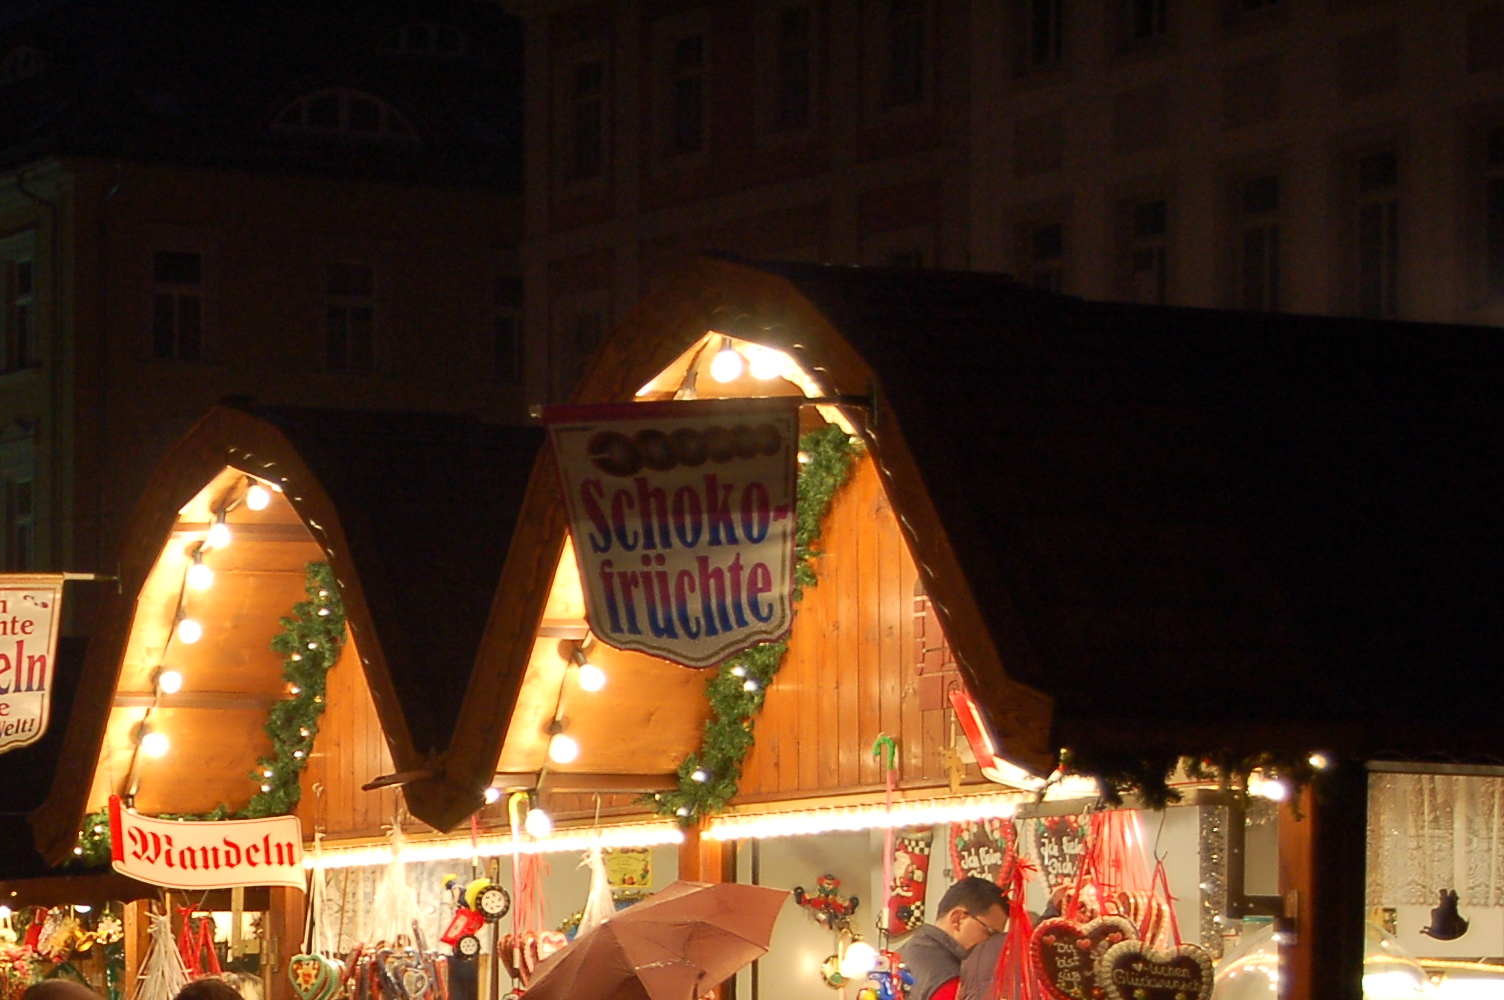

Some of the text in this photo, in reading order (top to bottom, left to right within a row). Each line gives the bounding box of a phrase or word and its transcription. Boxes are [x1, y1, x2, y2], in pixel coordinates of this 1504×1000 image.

[580, 474, 789, 554] Schoko-
[600, 553, 774, 640] früchte
[127, 826, 296, 870] Mandeln
